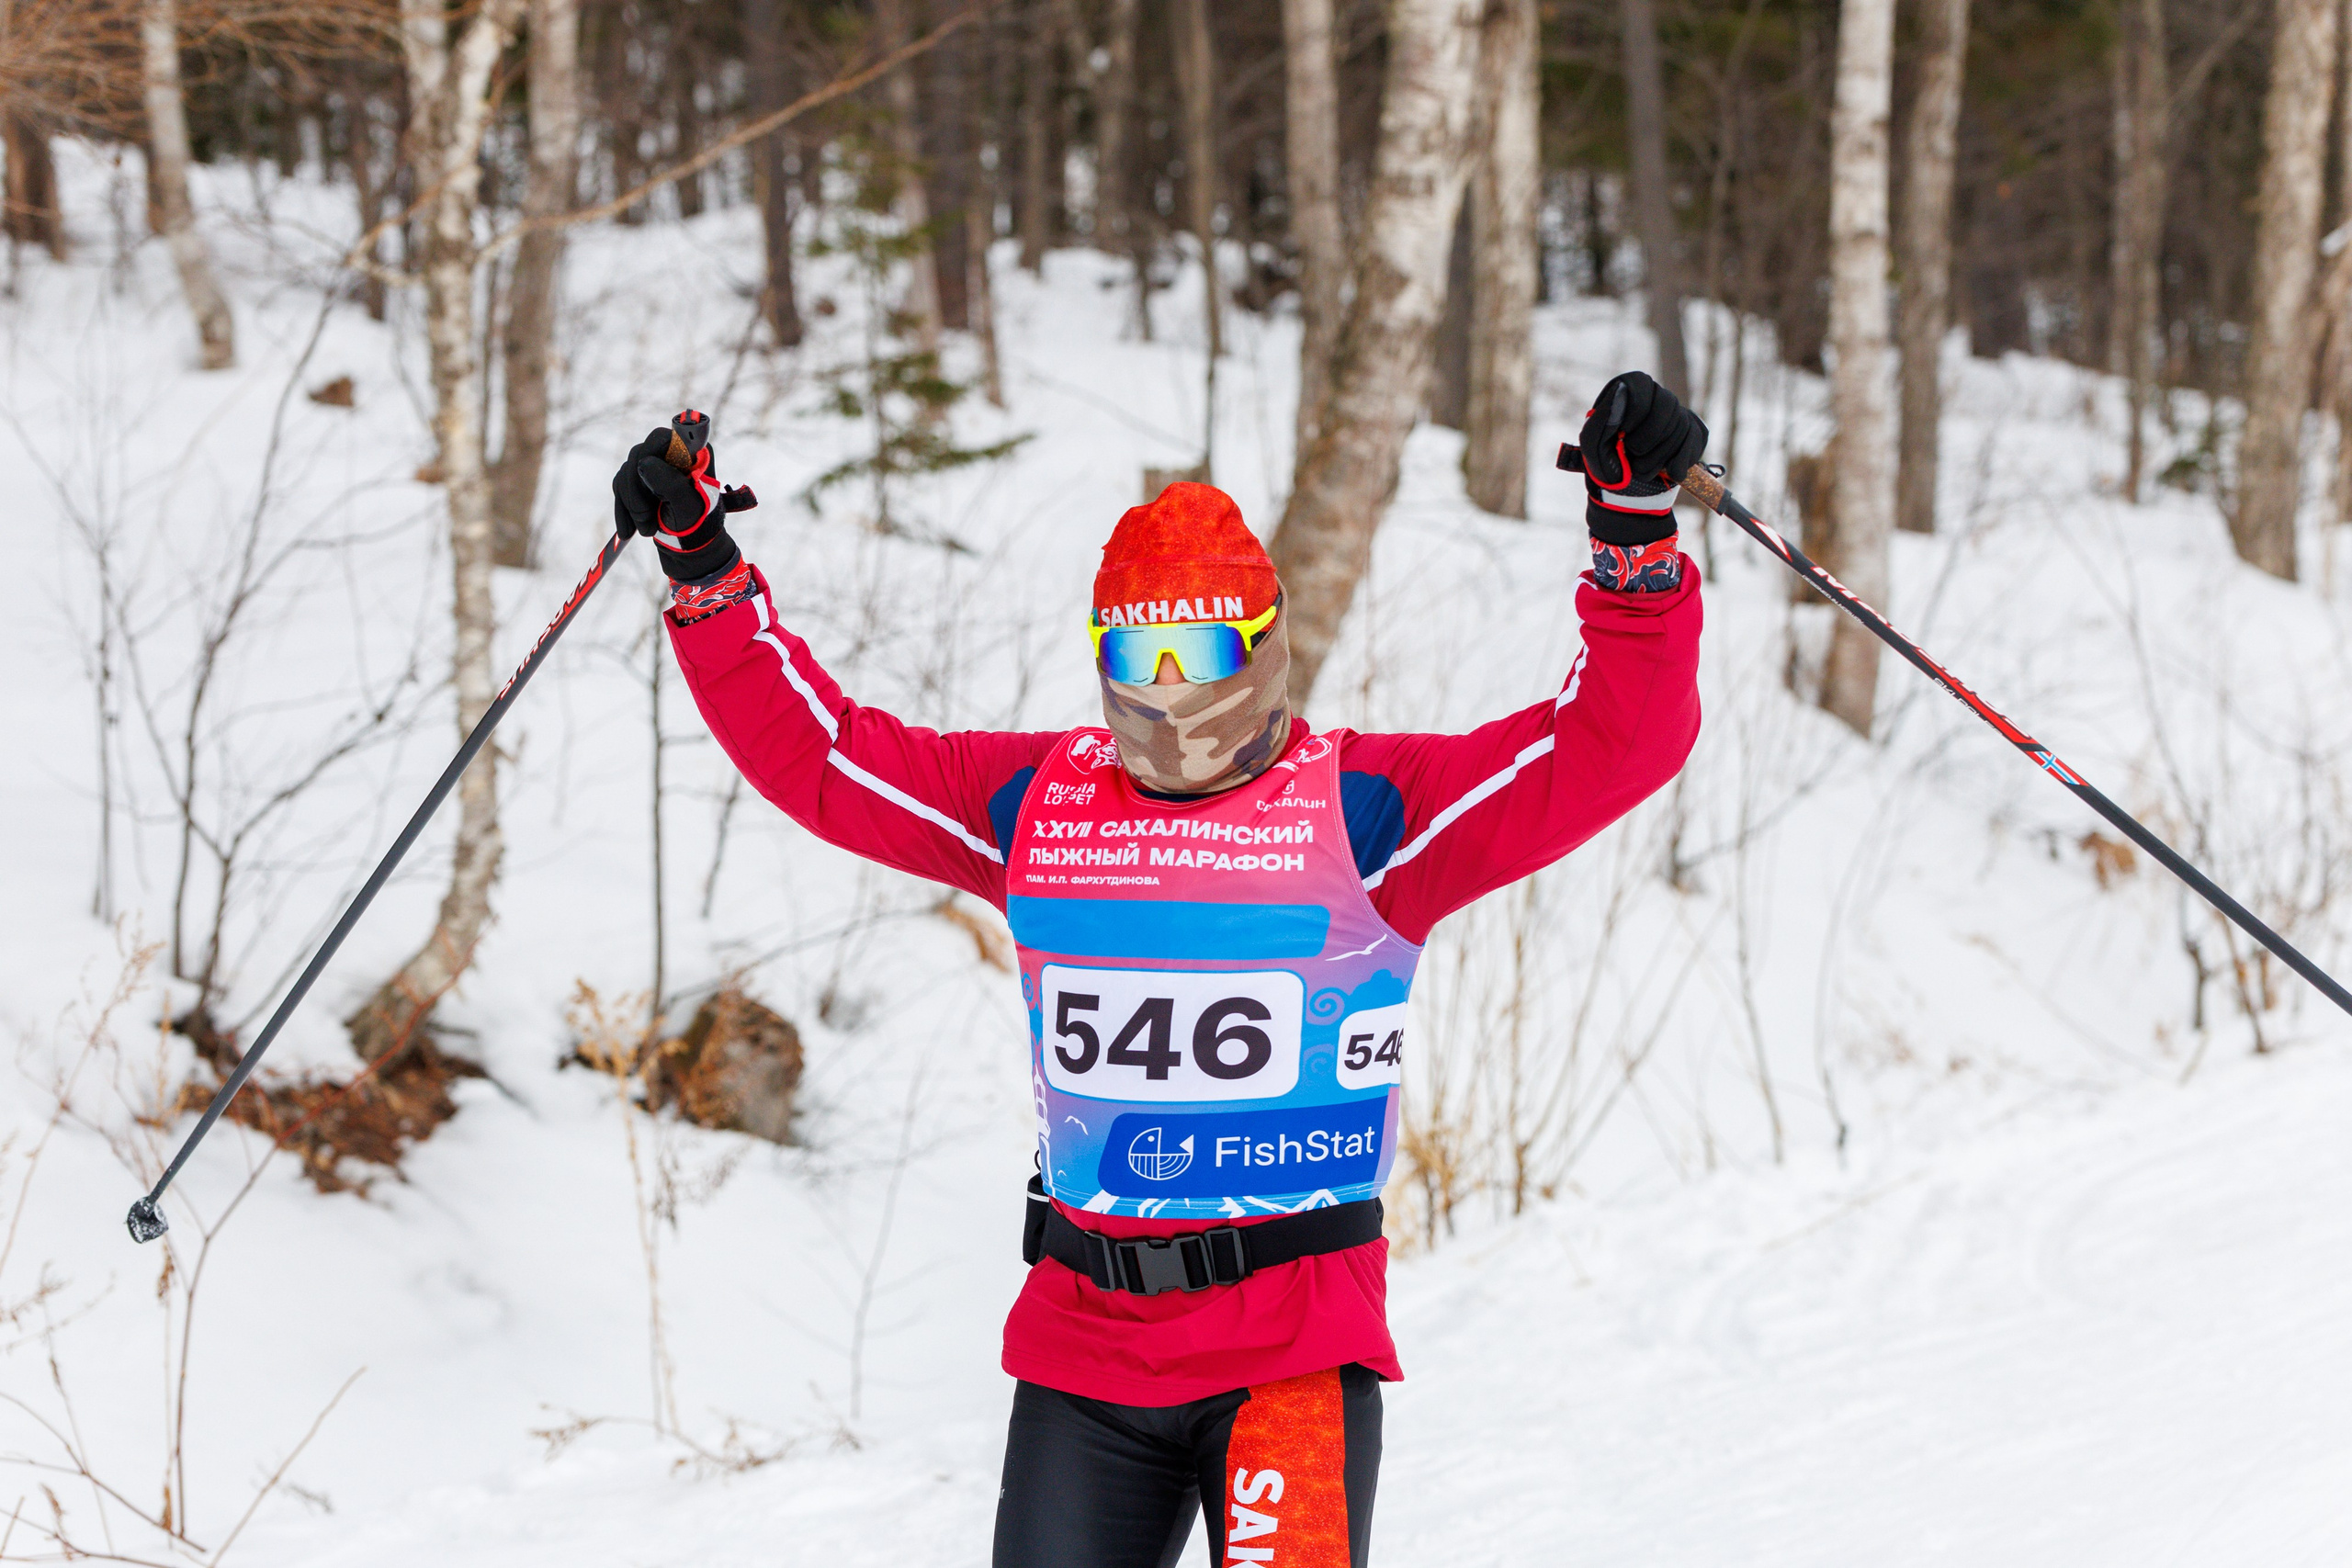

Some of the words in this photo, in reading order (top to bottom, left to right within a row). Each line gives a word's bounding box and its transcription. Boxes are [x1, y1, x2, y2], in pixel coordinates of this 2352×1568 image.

[1101, 596, 1244, 627] SAKHALIN
[1032, 820, 1093, 839] XXVII
[1099, 819, 1314, 844] САХАЛИНСКИЙ
[1028, 842, 1139, 866] ЛЫЖНЫЙ
[1149, 849, 1305, 871] МАРАФОН
[1026, 874, 1046, 884] ПАМ.
[1048, 875, 1068, 885] И.П.
[1070, 876, 1160, 886] ФАРХУТДИНОВА
[1055, 990, 1272, 1080] 546
[1216, 1125, 1375, 1168] FishStat
